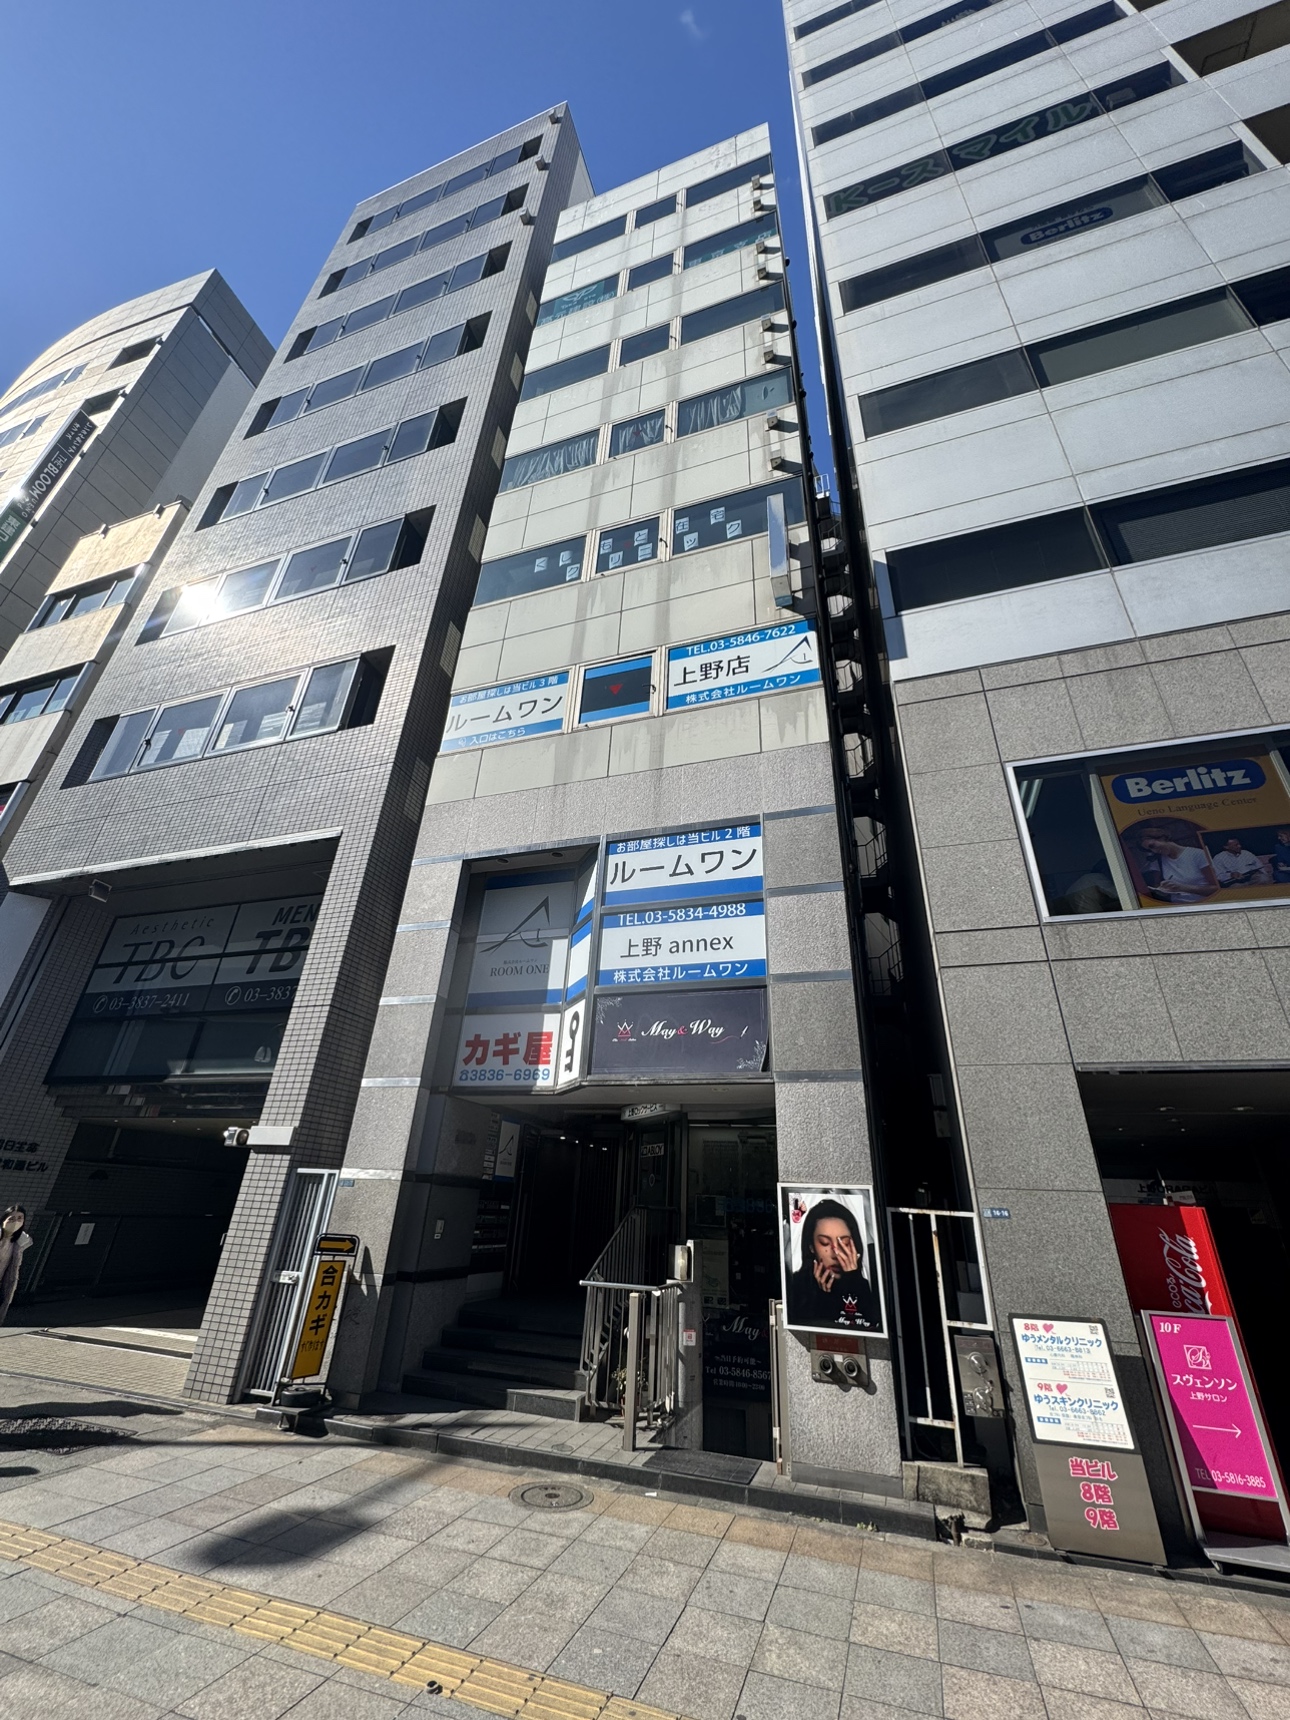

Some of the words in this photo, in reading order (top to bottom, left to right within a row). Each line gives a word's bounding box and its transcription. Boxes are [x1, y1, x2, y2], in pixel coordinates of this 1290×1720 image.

[1029, 211, 1104, 241] Berlitz
[53, 454, 68, 469] THE
[29, 460, 59, 499] BLOOM
[686, 624, 796, 656] TEL.03-5846-7622
[674, 655, 750, 687] 上野店
[685, 674, 801, 704] 株式会社ルームワン
[446, 696, 563, 734] ルームワン
[469, 727, 526, 746] 入口はこちら
[1125, 766, 1251, 799] Berlitz
[1137, 805, 1166, 817] Ueno
[1167, 800, 1219, 815] Language
[1221, 795, 1257, 806] Center
[609, 848, 757, 886] ルームワン
[130, 915, 215, 936] Aesthetic
[618, 902, 747, 927] TEL.03-5834-4988
[620, 937, 662, 959] 上野
[669, 935, 734, 954] annex
[112, 935, 206, 985] TBC
[490, 965, 523, 977] ROOM
[526, 963, 550, 974] ONE
[613, 962, 748, 983] 株式会社ルームワン
[109, 992, 190, 1010] 03-3837-2411
[463, 1031, 554, 1066] カギ屋
[469, 1067, 551, 1082] 3836-6969
[309, 1265, 338, 1335] 合カギ
[1021, 1333, 1103, 1348] ゆうメンタルクリニック
[1172, 1373, 1238, 1391] スヴェンソン
[1033, 1394, 1119, 1411] ゆうスキンクリニック
[1190, 1391, 1228, 1403] 上野サロン
[1069, 1457, 1118, 1481] 当ビル
[1195, 1466, 1211, 1481] TEL
[1080, 1482, 1113, 1504] 8階
[1085, 1507, 1119, 1530] 9階
